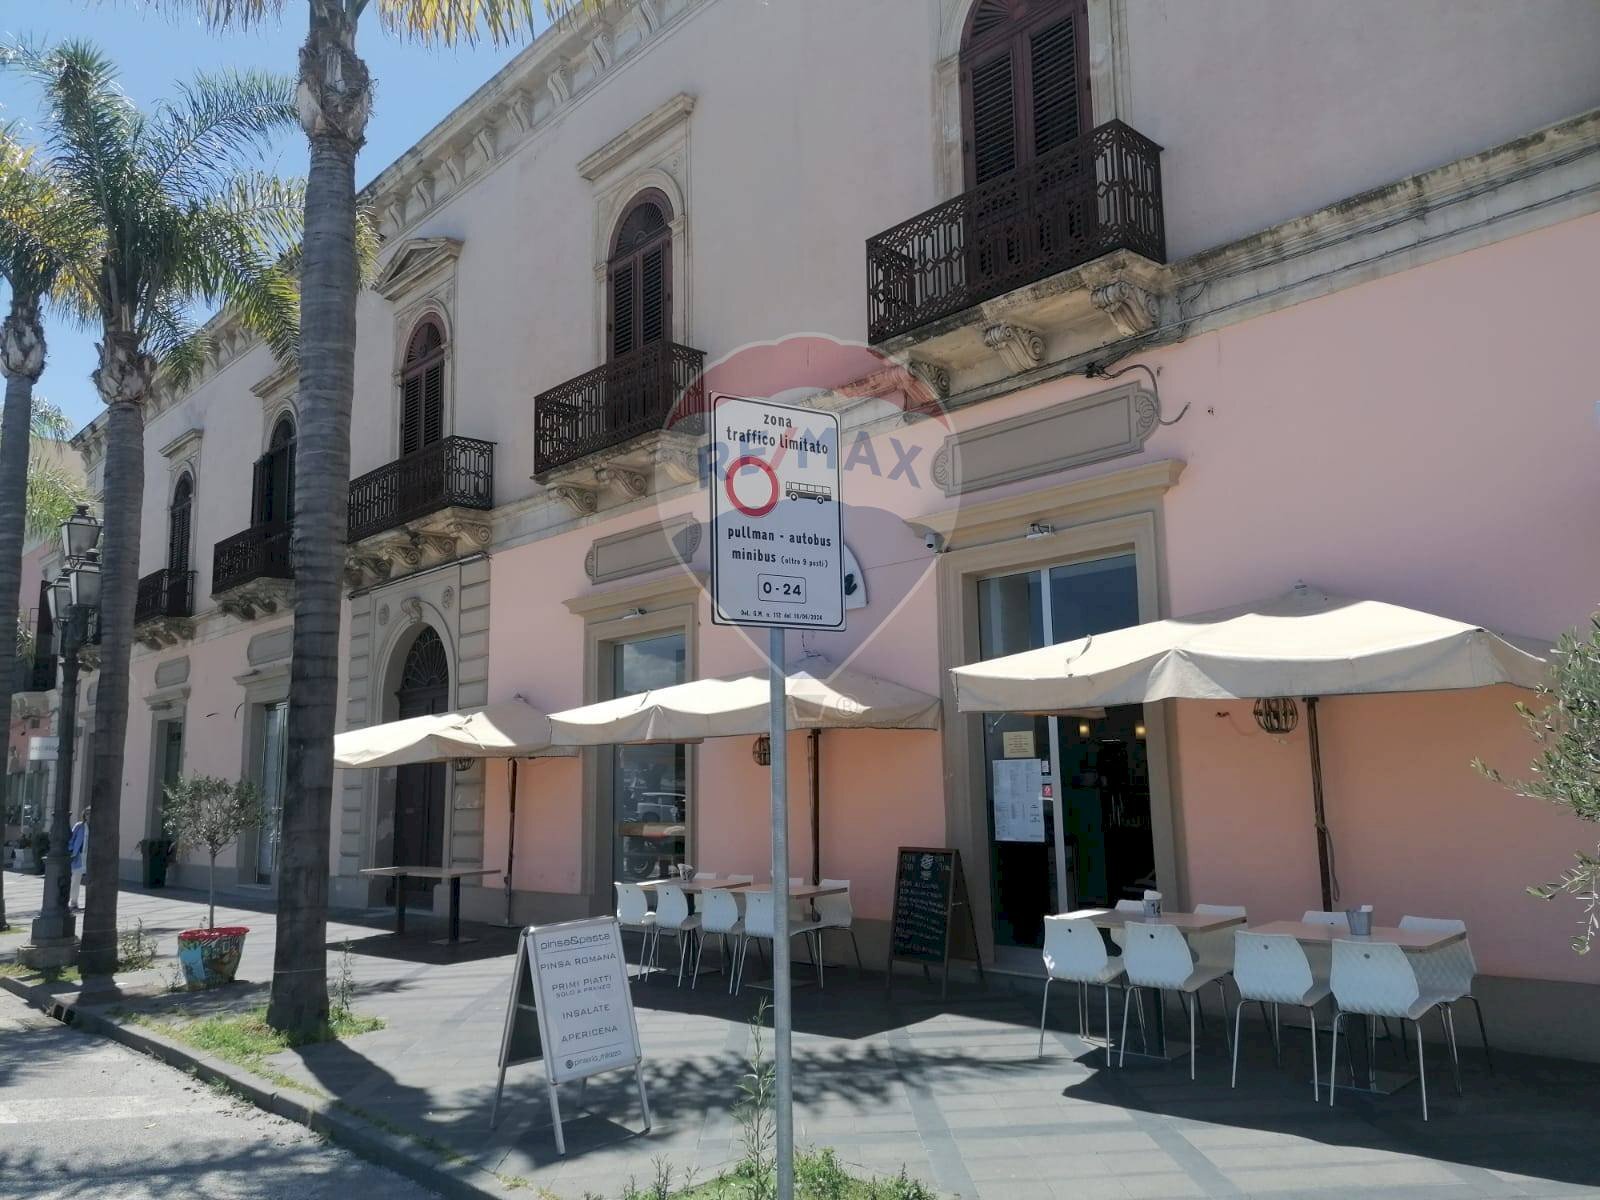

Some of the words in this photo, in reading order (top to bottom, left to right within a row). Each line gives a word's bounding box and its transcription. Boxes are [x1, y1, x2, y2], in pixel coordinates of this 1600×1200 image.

[763, 414, 793, 428] zona
[727, 426, 776, 446] traffico
[779, 434, 829, 454] limitato
[727, 526, 775, 541] pullman
[789, 533, 832, 547] autobus
[732, 548, 777, 562] minibus
[540, 960, 571, 971] PINSA
[575, 953, 617, 965] ROMANA
[552, 981, 581, 991] PRIMI
[583, 975, 612, 986] PIATTI
[556, 989, 576, 998] SOLO
[562, 1003, 611, 1019] INSALATE
[561, 1025, 618, 1042] APERICENA
